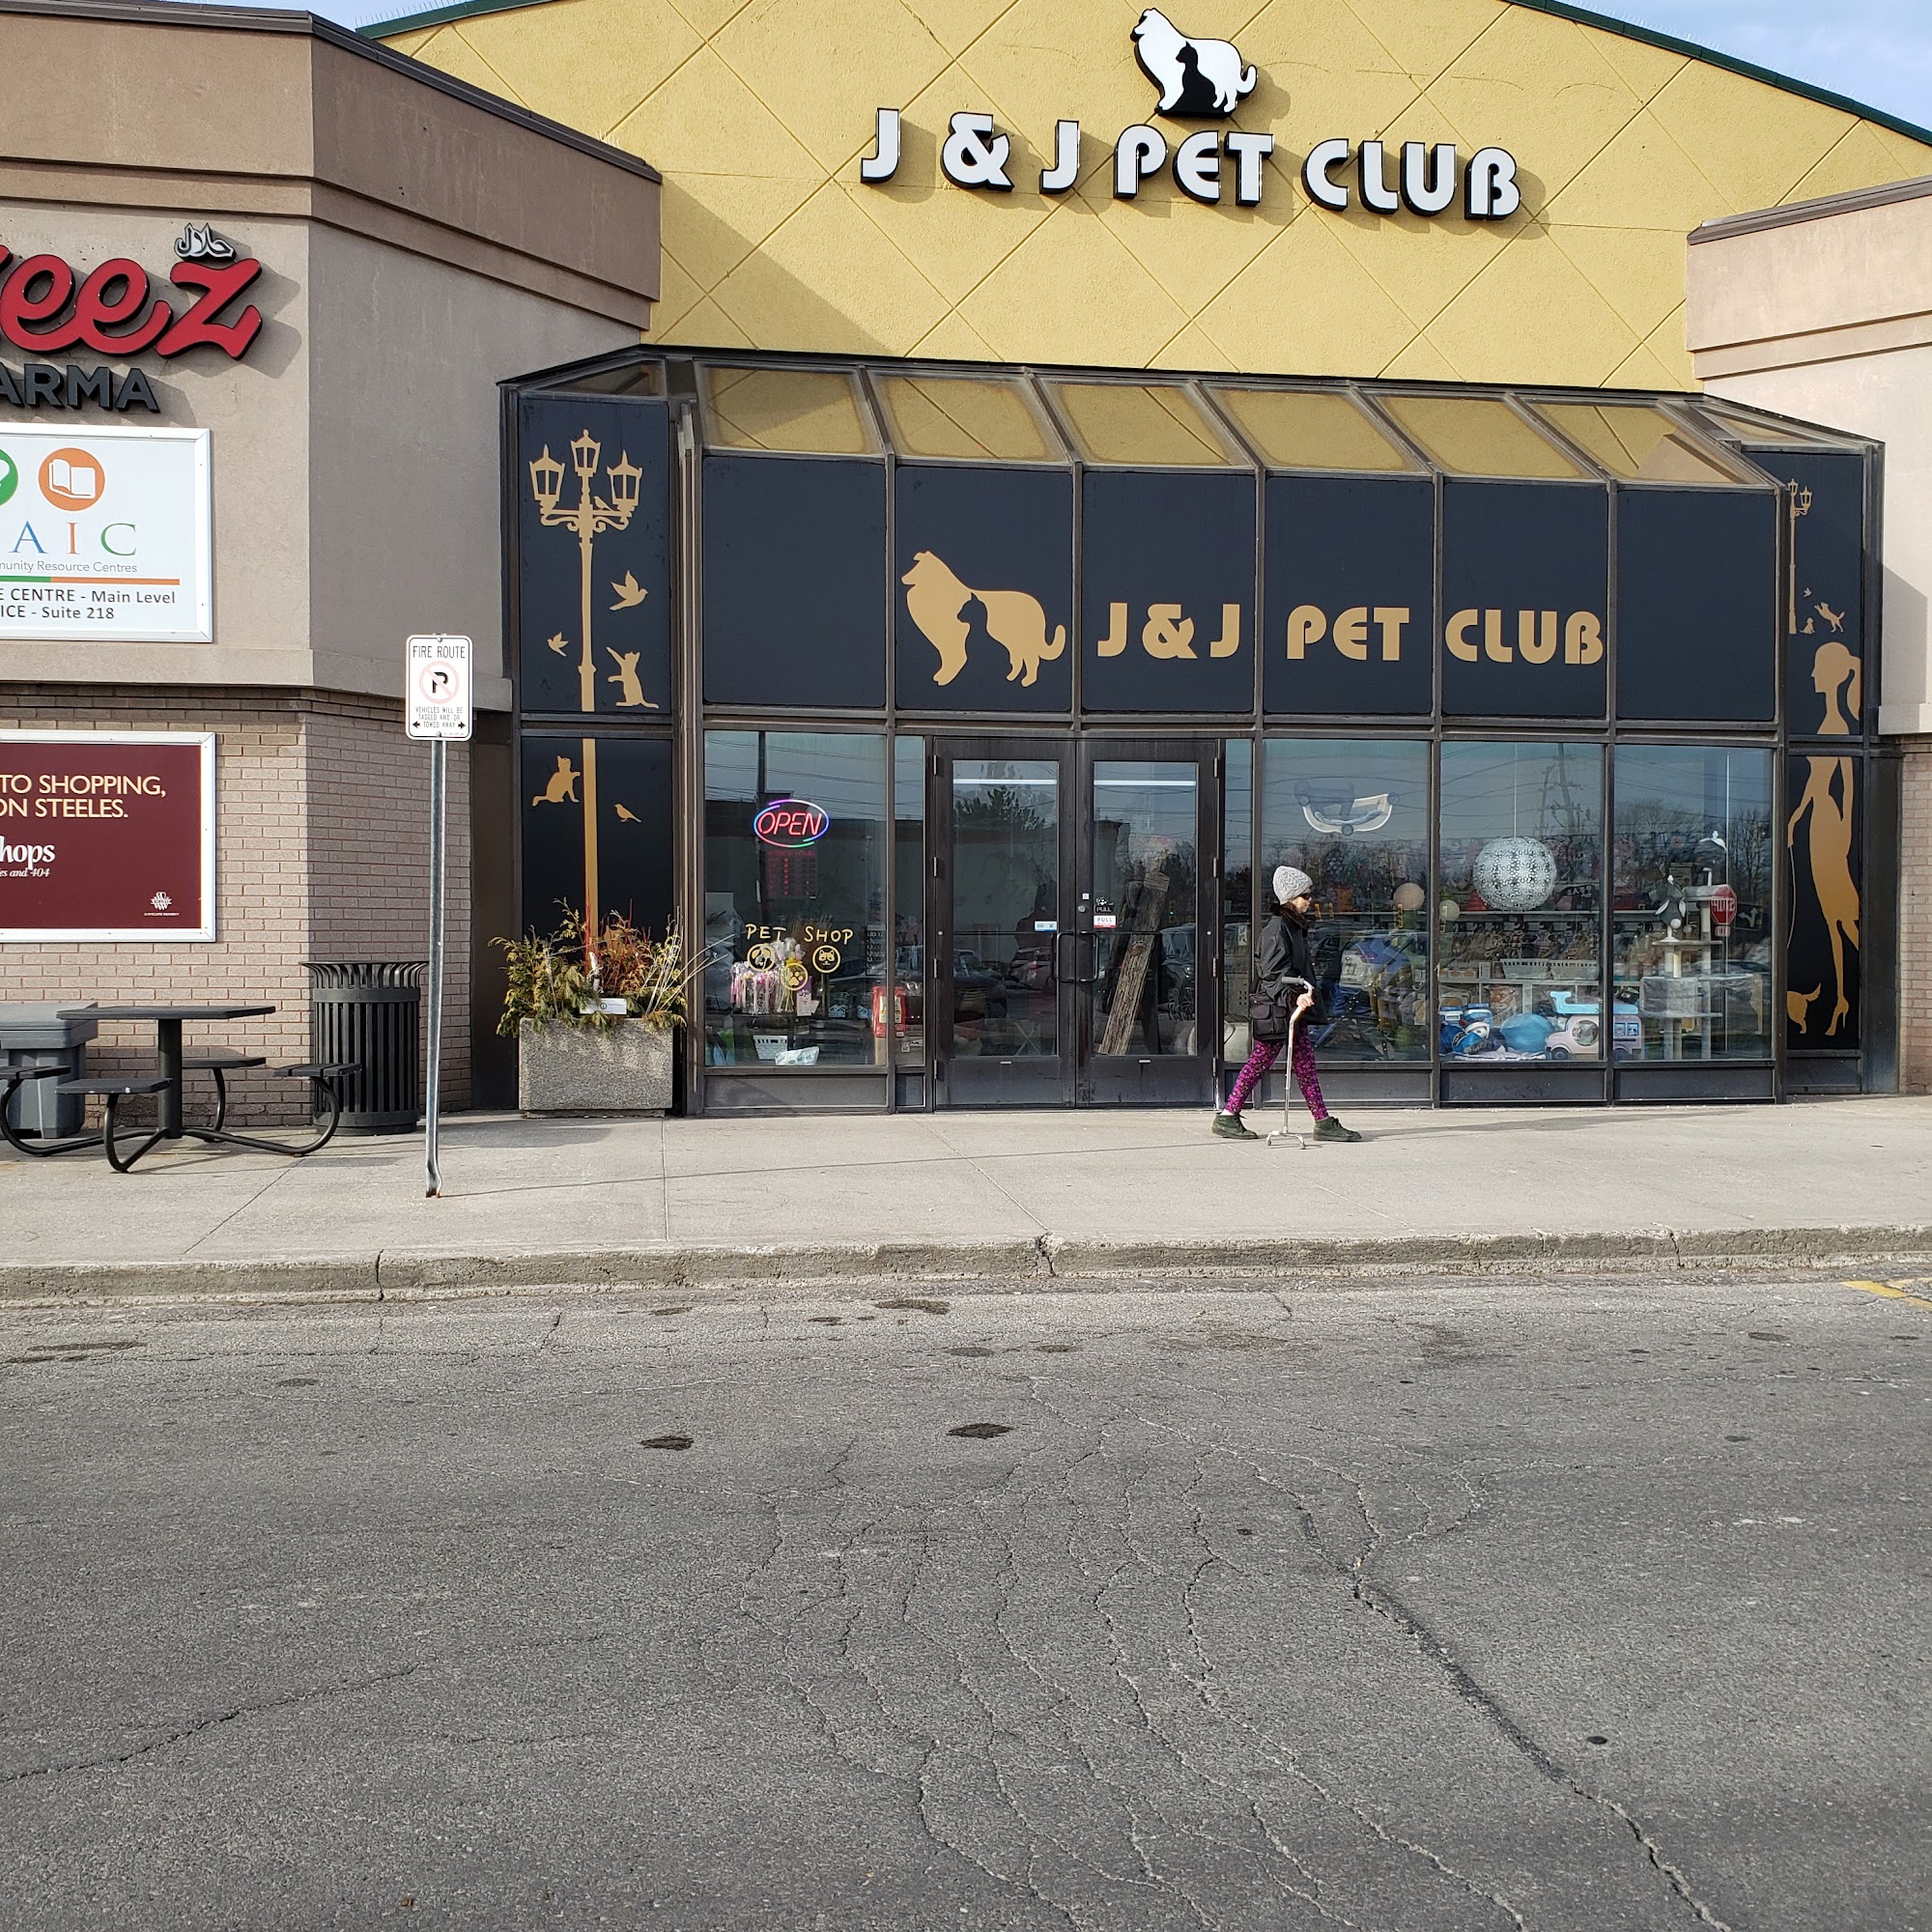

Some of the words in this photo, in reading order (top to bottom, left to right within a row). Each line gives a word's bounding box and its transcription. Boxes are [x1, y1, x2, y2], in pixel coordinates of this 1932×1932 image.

[861, 107, 900, 184] J
[941, 111, 1014, 192] &
[1039, 120, 1080, 194] J
[1113, 124, 1274, 207] PET
[1301, 138, 1521, 220] CLUB
[0, 244, 263, 360] eez
[37, 560, 90, 572] Resource
[93, 561, 137, 573] Centres
[10, 587, 75, 602] CENTRE
[91, 590, 130, 603] Main
[136, 591, 175, 604] Level
[0, 605, 26, 618] ICE
[42, 607, 81, 619] Suite
[86, 608, 115, 619] 218
[1097, 602, 1127, 657] J
[1142, 603, 1198, 659] &
[1209, 604, 1240, 658] J
[1287, 605, 1409, 661] PET
[1445, 609, 1604, 665] CLUB
[412, 645, 433, 658] FIRE
[437, 645, 466, 659] ROUTE
[0, 774, 32, 794] TO
[39, 775, 166, 797] SHOPPING,
[35, 799, 129, 818] STEELES.
[757, 811, 822, 836] OPEN
[9, 867, 28, 878] and
[30, 867, 50, 878] 404
[745, 923, 786, 941] PET
[804, 925, 854, 945] SHOP
